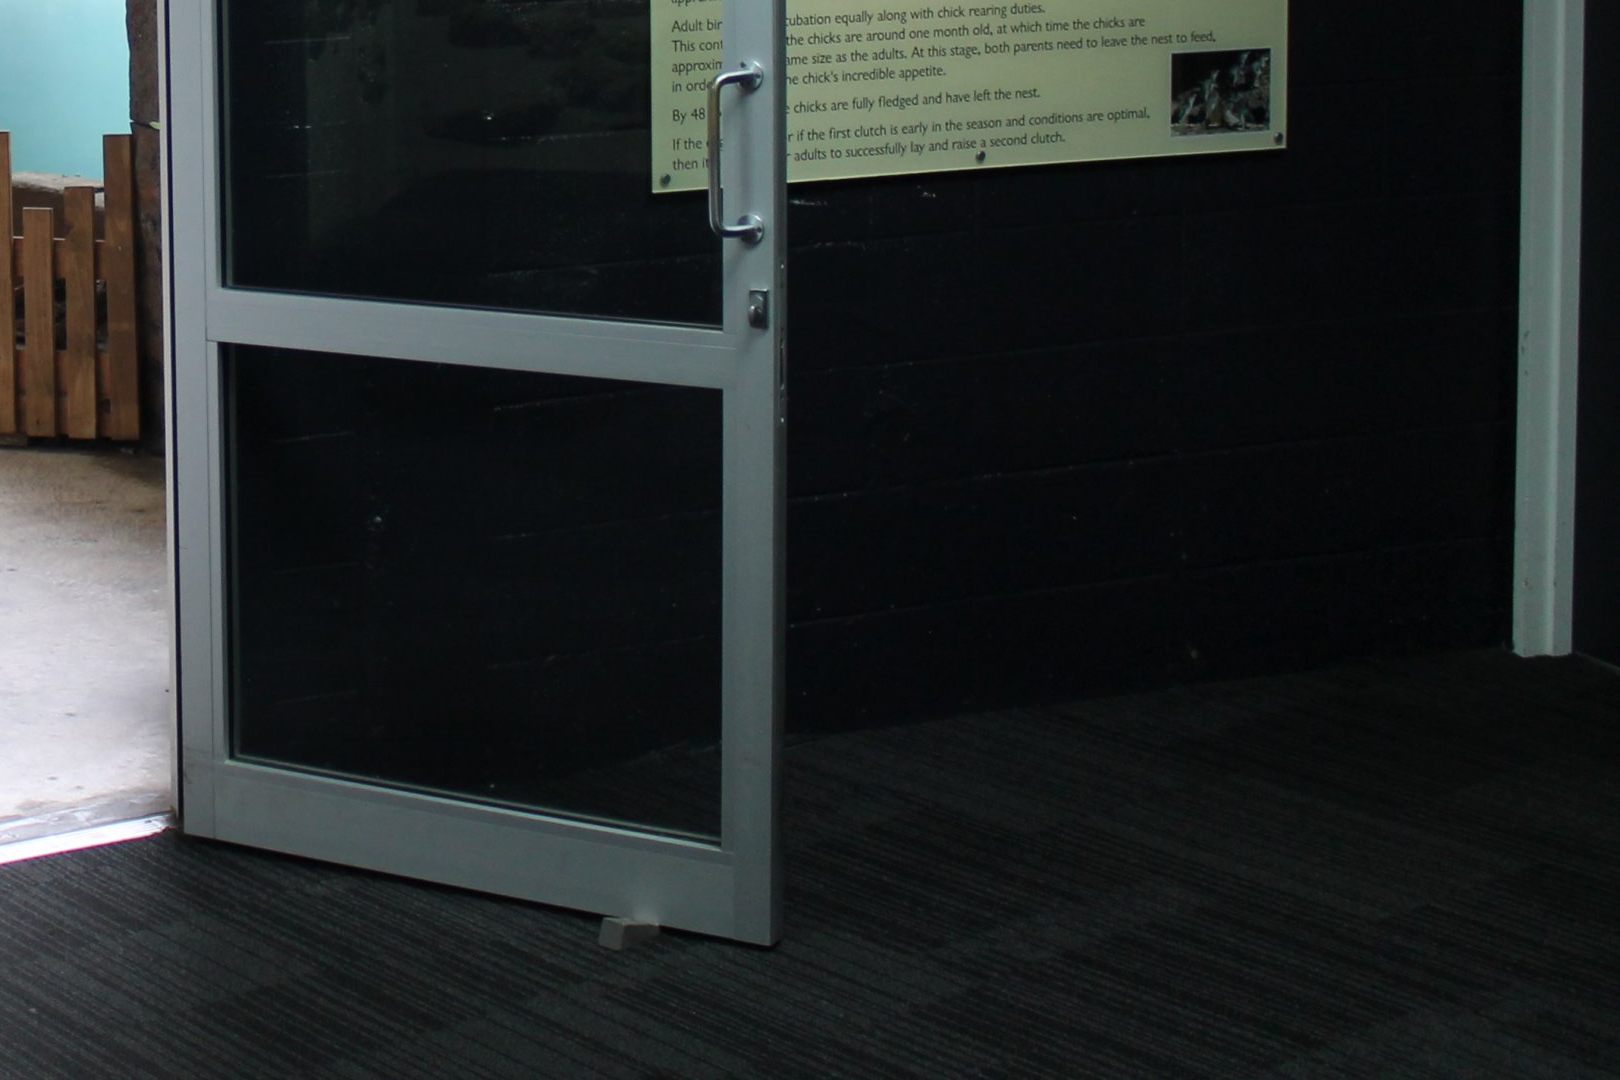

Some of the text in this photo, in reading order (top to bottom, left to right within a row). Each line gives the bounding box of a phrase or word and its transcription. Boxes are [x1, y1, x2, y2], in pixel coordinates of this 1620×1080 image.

[672, 87, 1042, 126] By 48 chicks are fully fledged and have left the nest.
